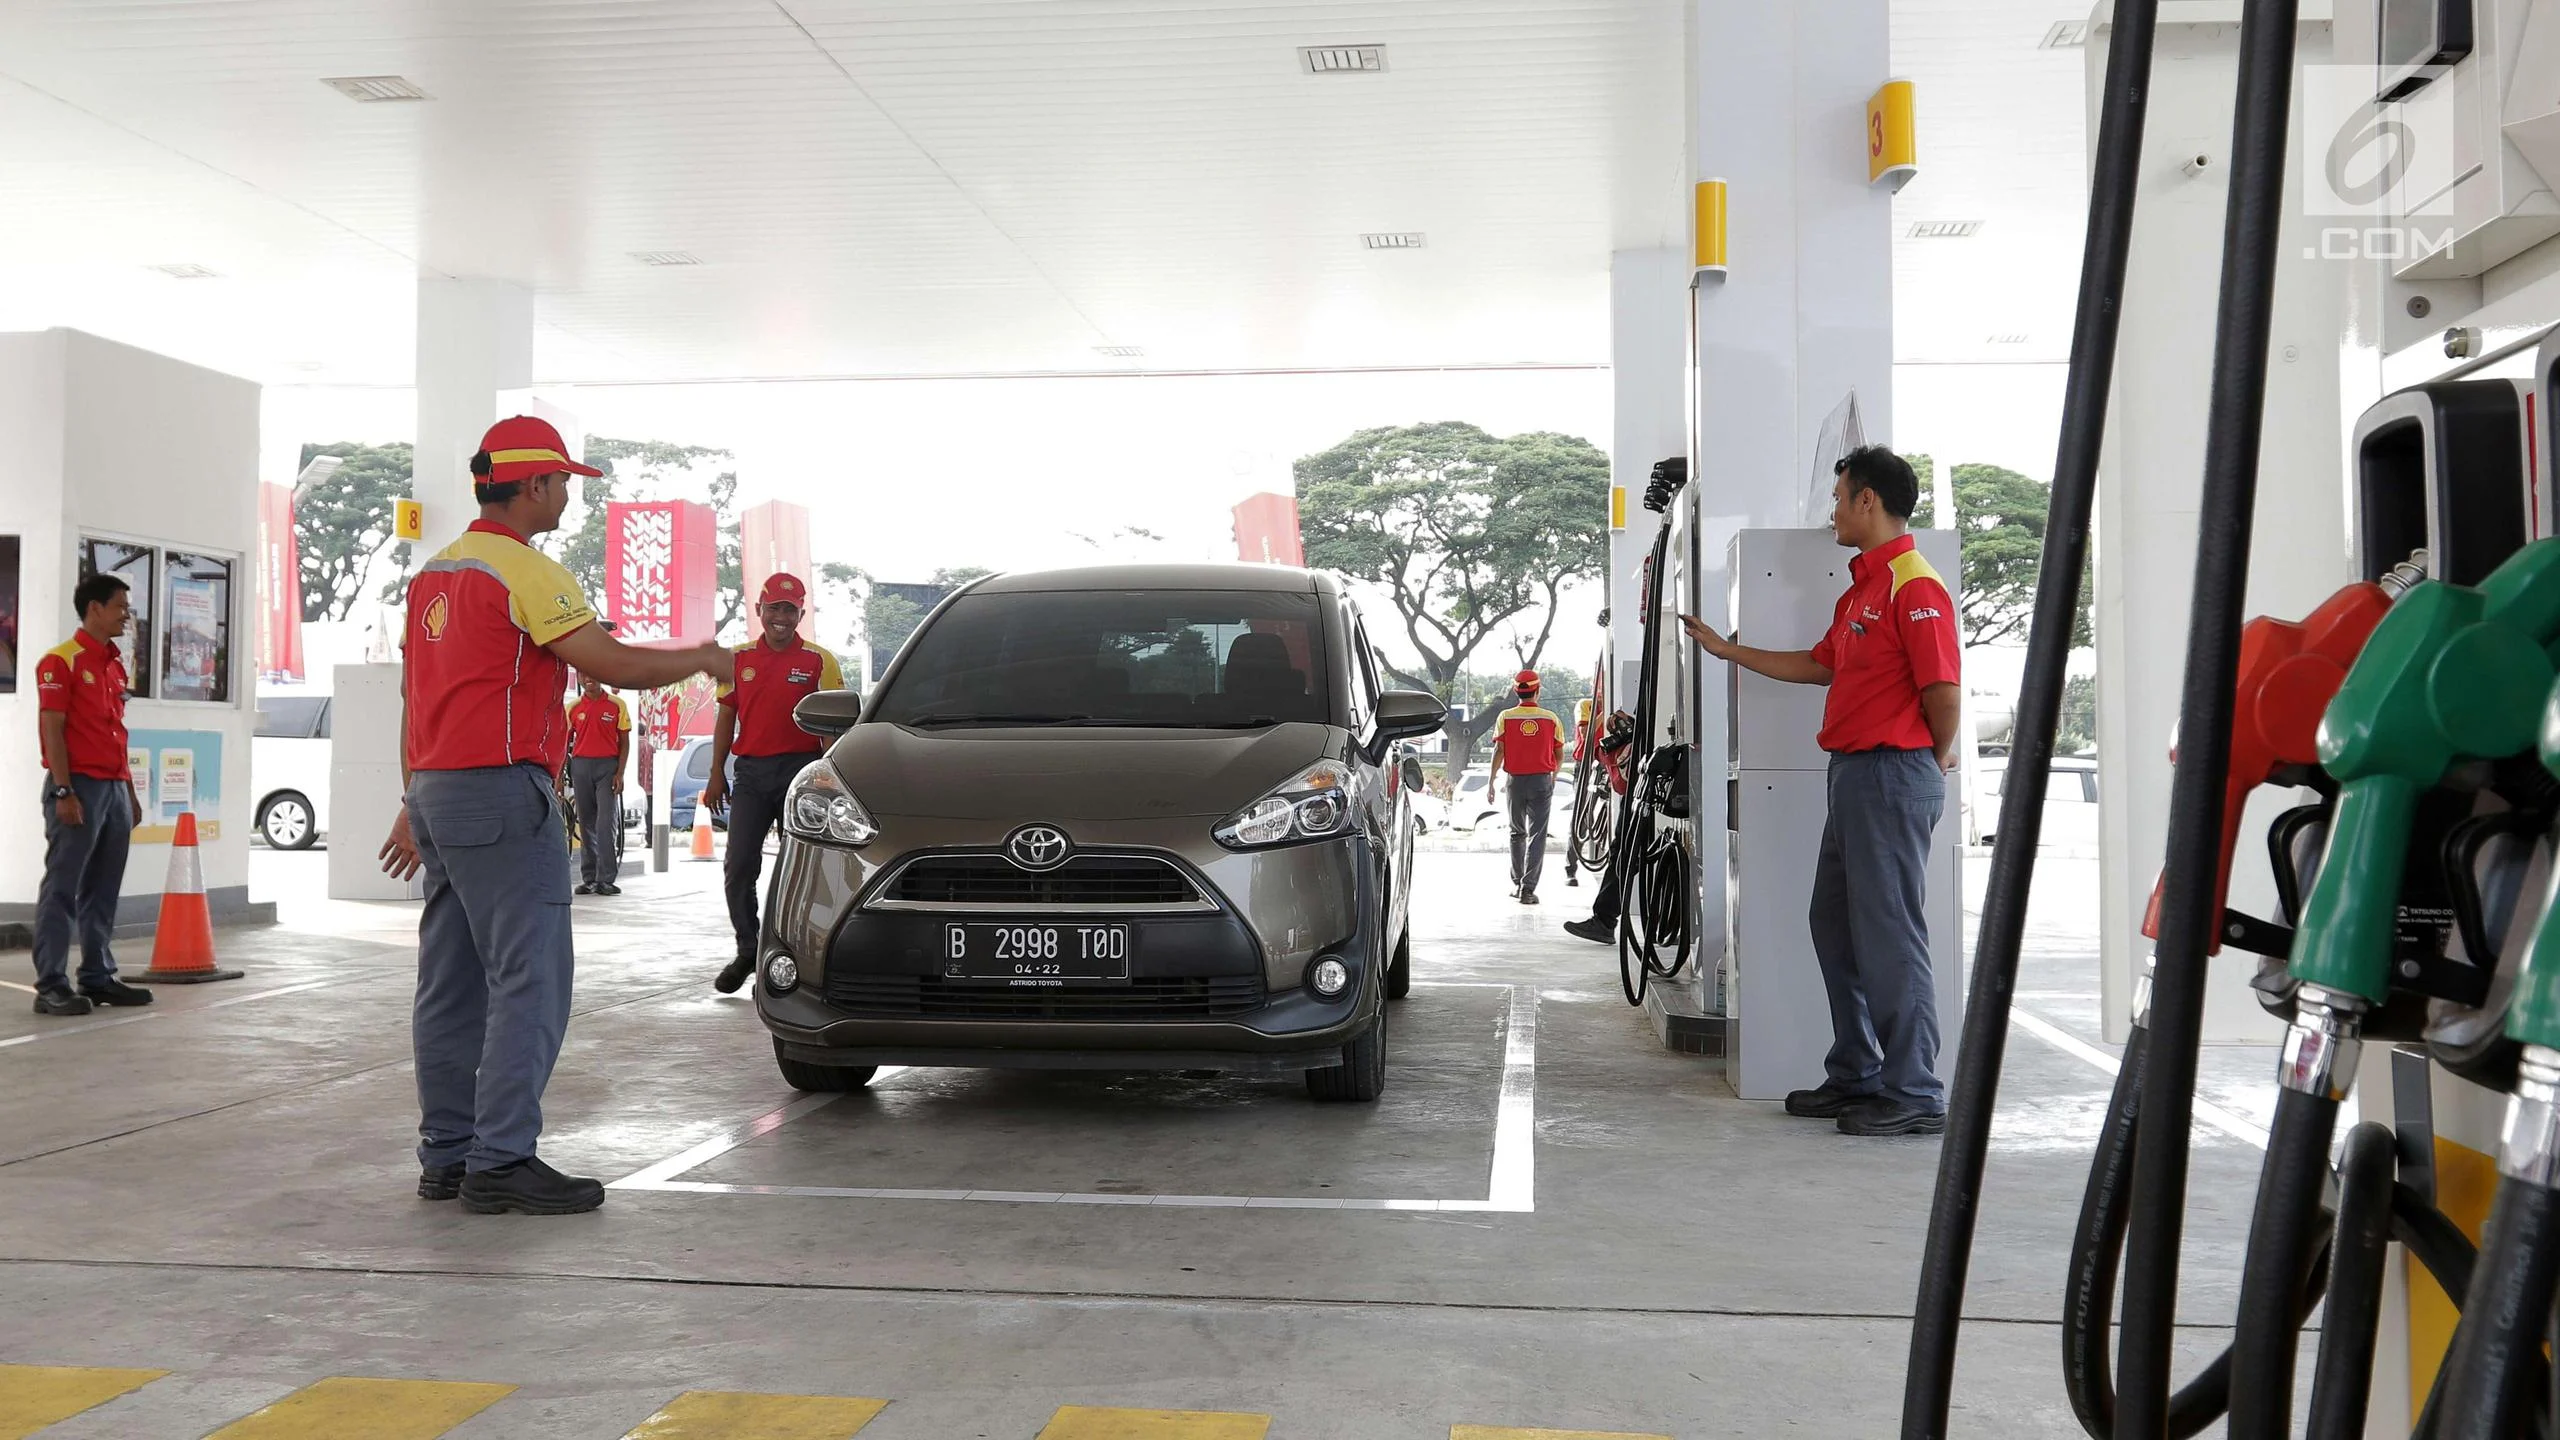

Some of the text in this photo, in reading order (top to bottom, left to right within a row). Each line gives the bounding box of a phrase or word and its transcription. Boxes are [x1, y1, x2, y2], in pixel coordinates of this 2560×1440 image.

[1872, 110, 1883, 157] 3
[409, 509, 418, 530] 8
[1911, 608, 1941, 621] HELIX
[951, 928, 965, 959] B
[995, 928, 1058, 959] 2998
[2076, 1249, 2098, 1329] FUTURA
